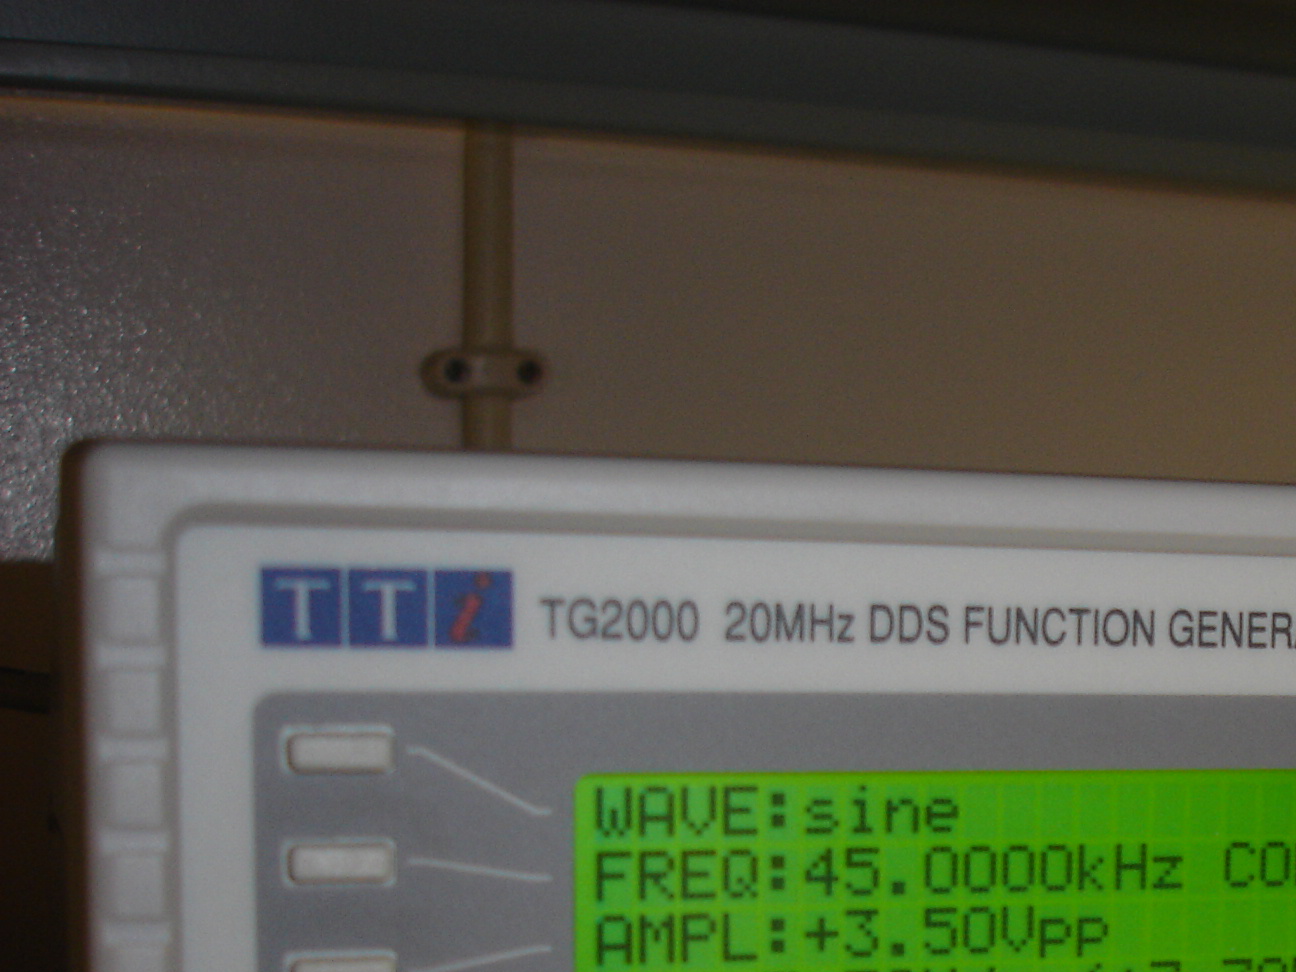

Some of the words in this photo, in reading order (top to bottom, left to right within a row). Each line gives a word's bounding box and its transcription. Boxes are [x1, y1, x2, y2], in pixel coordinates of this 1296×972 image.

[540, 597, 699, 641] TG2000
[725, 601, 853, 641] 20MHz
[869, 604, 949, 645] DDS
[964, 605, 1155, 647] FUNCTION
